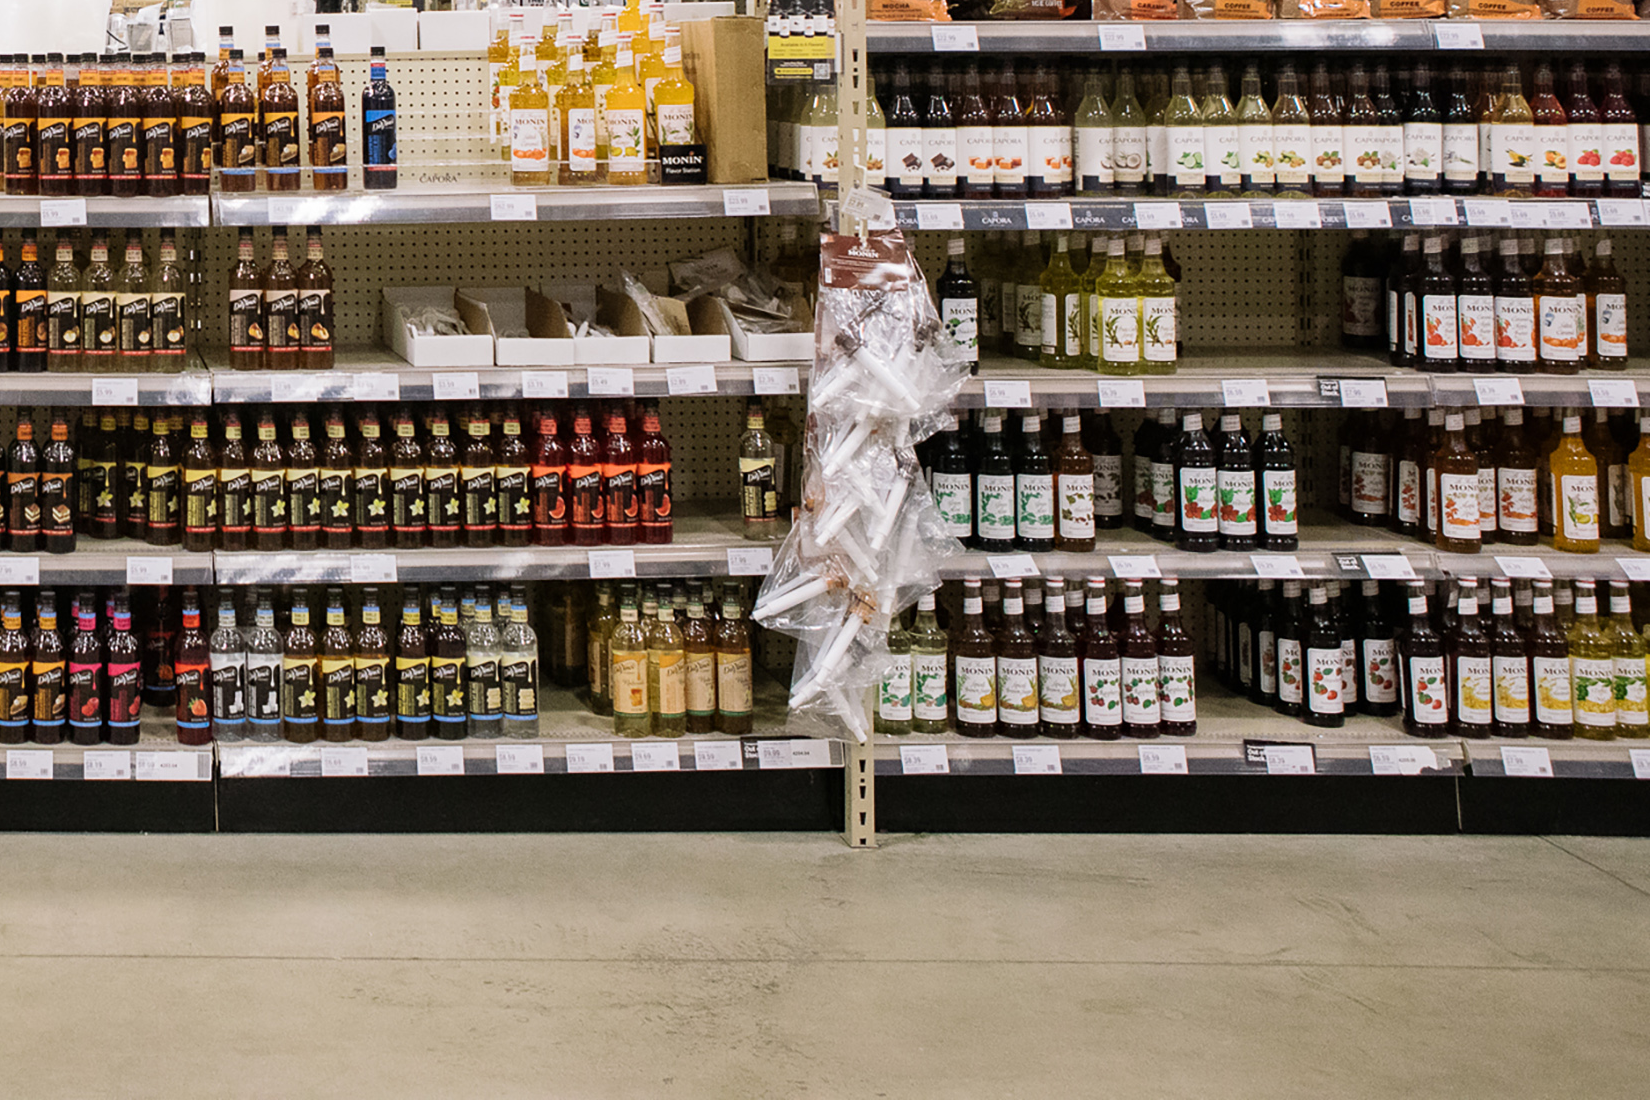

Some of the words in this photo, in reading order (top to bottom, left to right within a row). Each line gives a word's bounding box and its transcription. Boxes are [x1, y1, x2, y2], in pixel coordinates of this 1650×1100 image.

[515, 118, 546, 126] MONIN
[662, 155, 703, 166] MONIN
[982, 215, 1013, 225] CAPORA
[1075, 215, 1105, 225] CAPORA
[848, 249, 879, 259] MONIN
